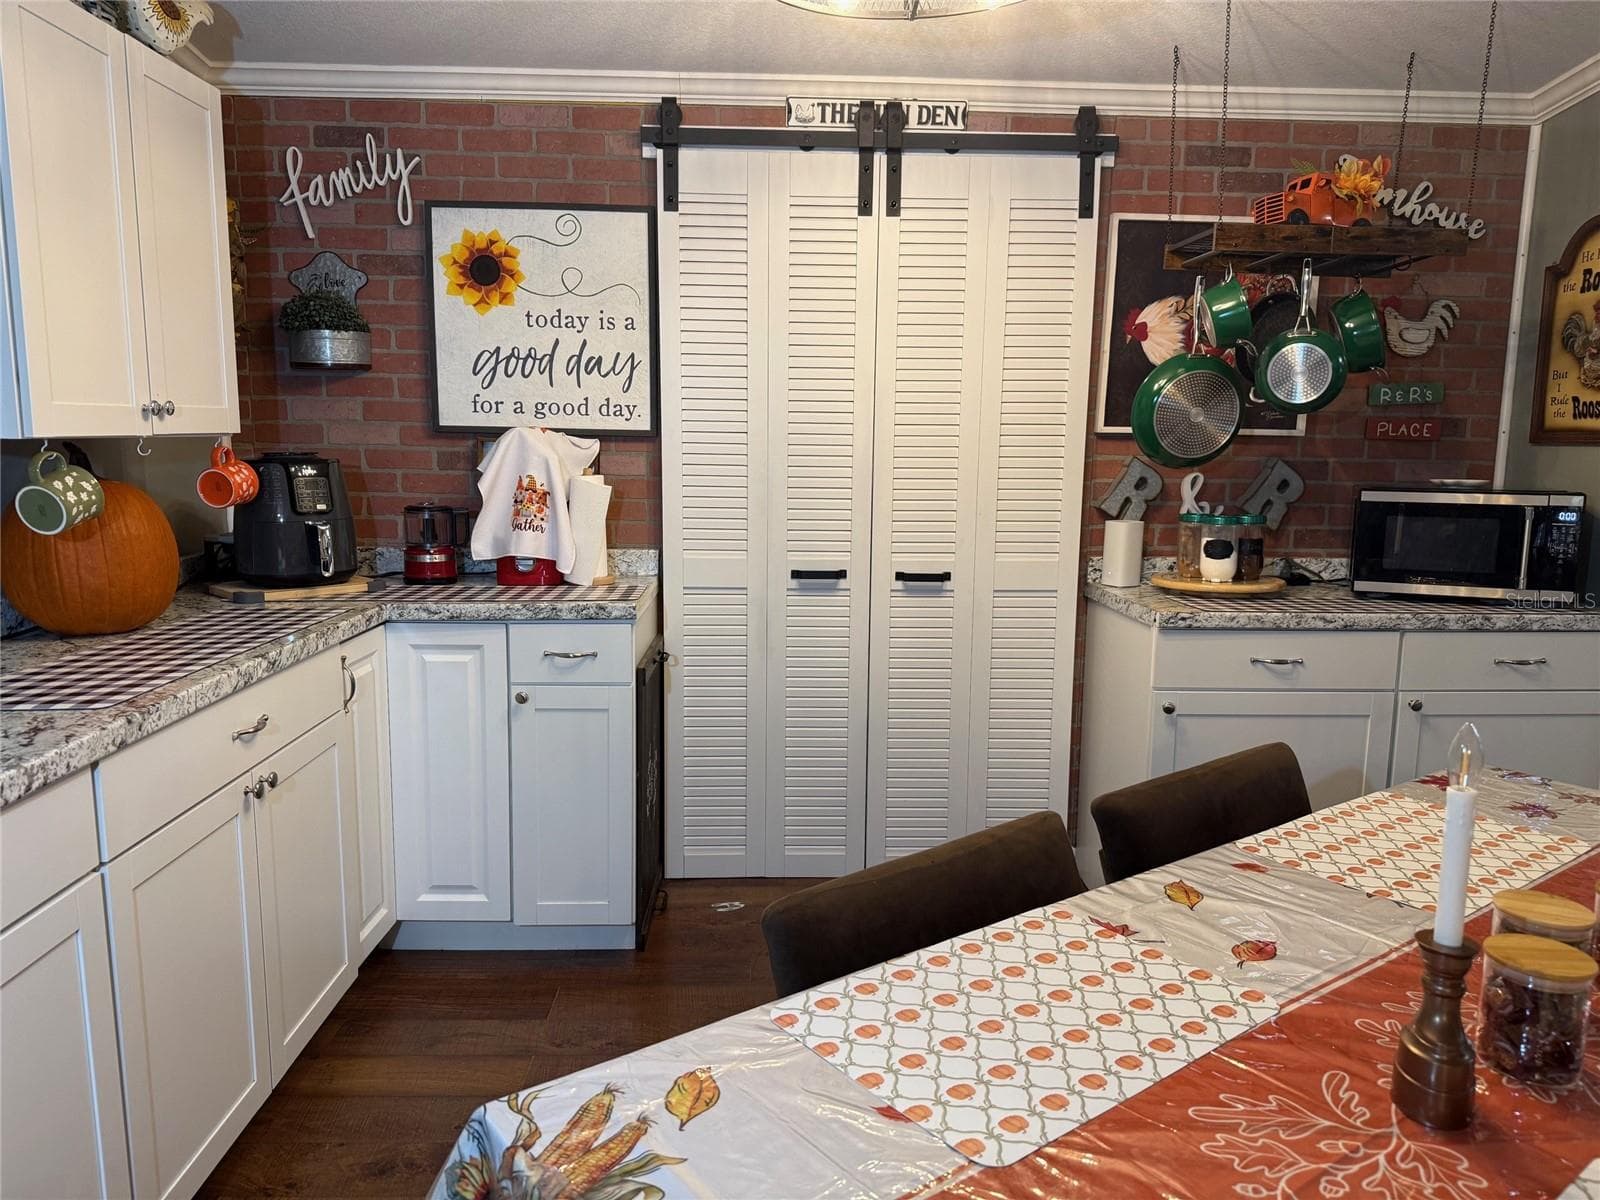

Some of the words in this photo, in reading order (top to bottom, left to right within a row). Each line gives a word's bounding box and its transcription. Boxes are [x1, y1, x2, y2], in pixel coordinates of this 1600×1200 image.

[917, 104, 960, 126] DEN
[280, 133, 421, 239] family
[1563, 281, 1577, 294] the
[524, 308, 589, 333] today
[599, 310, 616, 330] is
[624, 317, 636, 331] a
[472, 338, 559, 390] good
[566, 338, 642, 393] day
[1552, 370, 1568, 380] But
[471, 393, 504, 414] for
[513, 400, 525, 415] a
[533, 397, 590, 419] good
[598, 398, 641, 422] day.
[1551, 394, 1569, 406] Rule
[1553, 407, 1566, 418] the
[1377, 422, 1432, 437] PLACE
[512, 518, 546, 534] Gather
